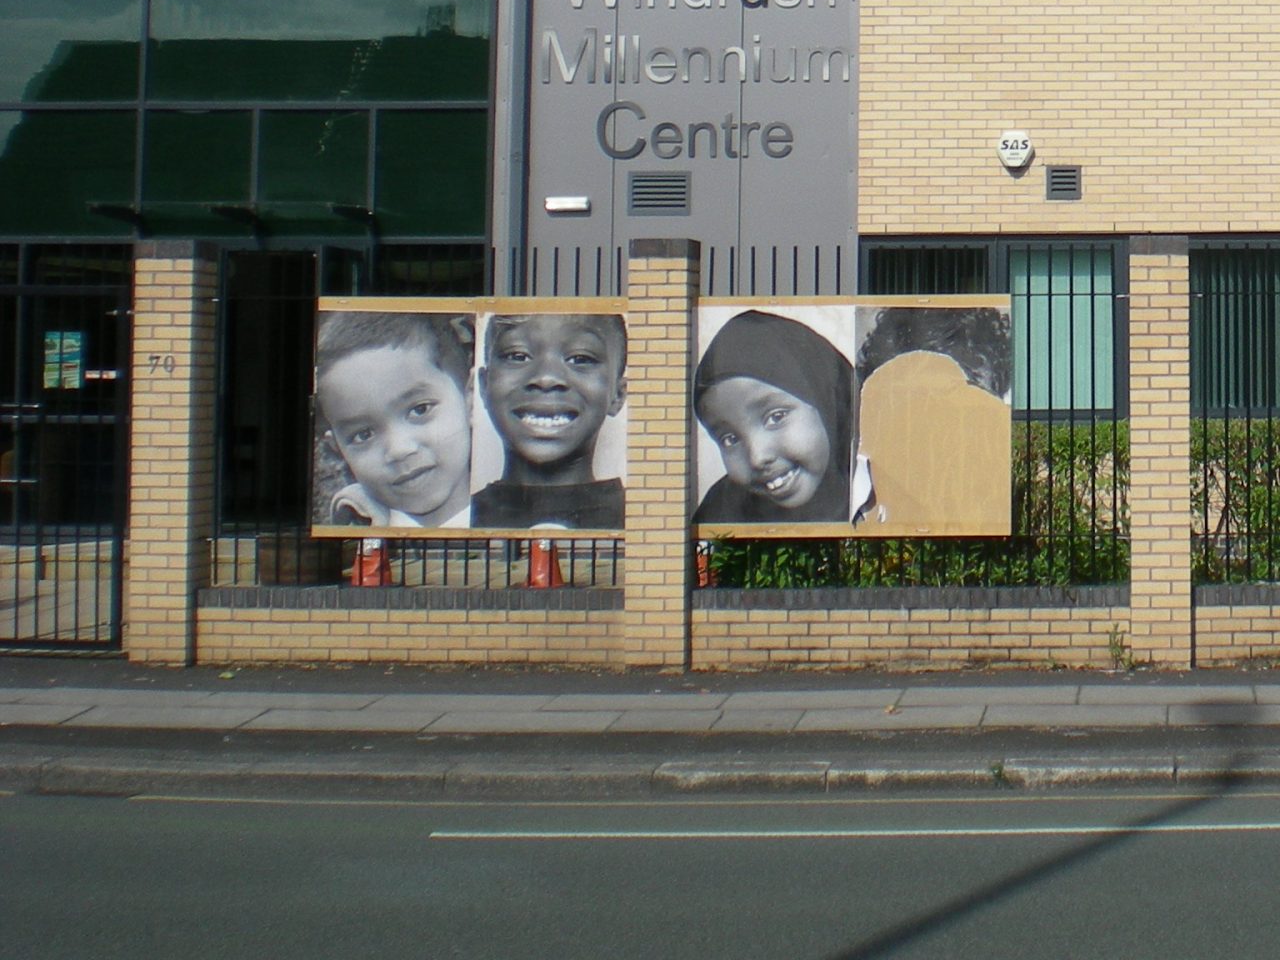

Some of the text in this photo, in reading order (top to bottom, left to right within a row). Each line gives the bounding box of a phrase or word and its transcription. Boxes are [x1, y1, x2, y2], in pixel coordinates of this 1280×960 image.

[541, 26, 851, 85] Millennium
[596, 100, 795, 161] Centre
[1000, 139, 1030, 151] SAS
[148, 355, 176, 374] 70
